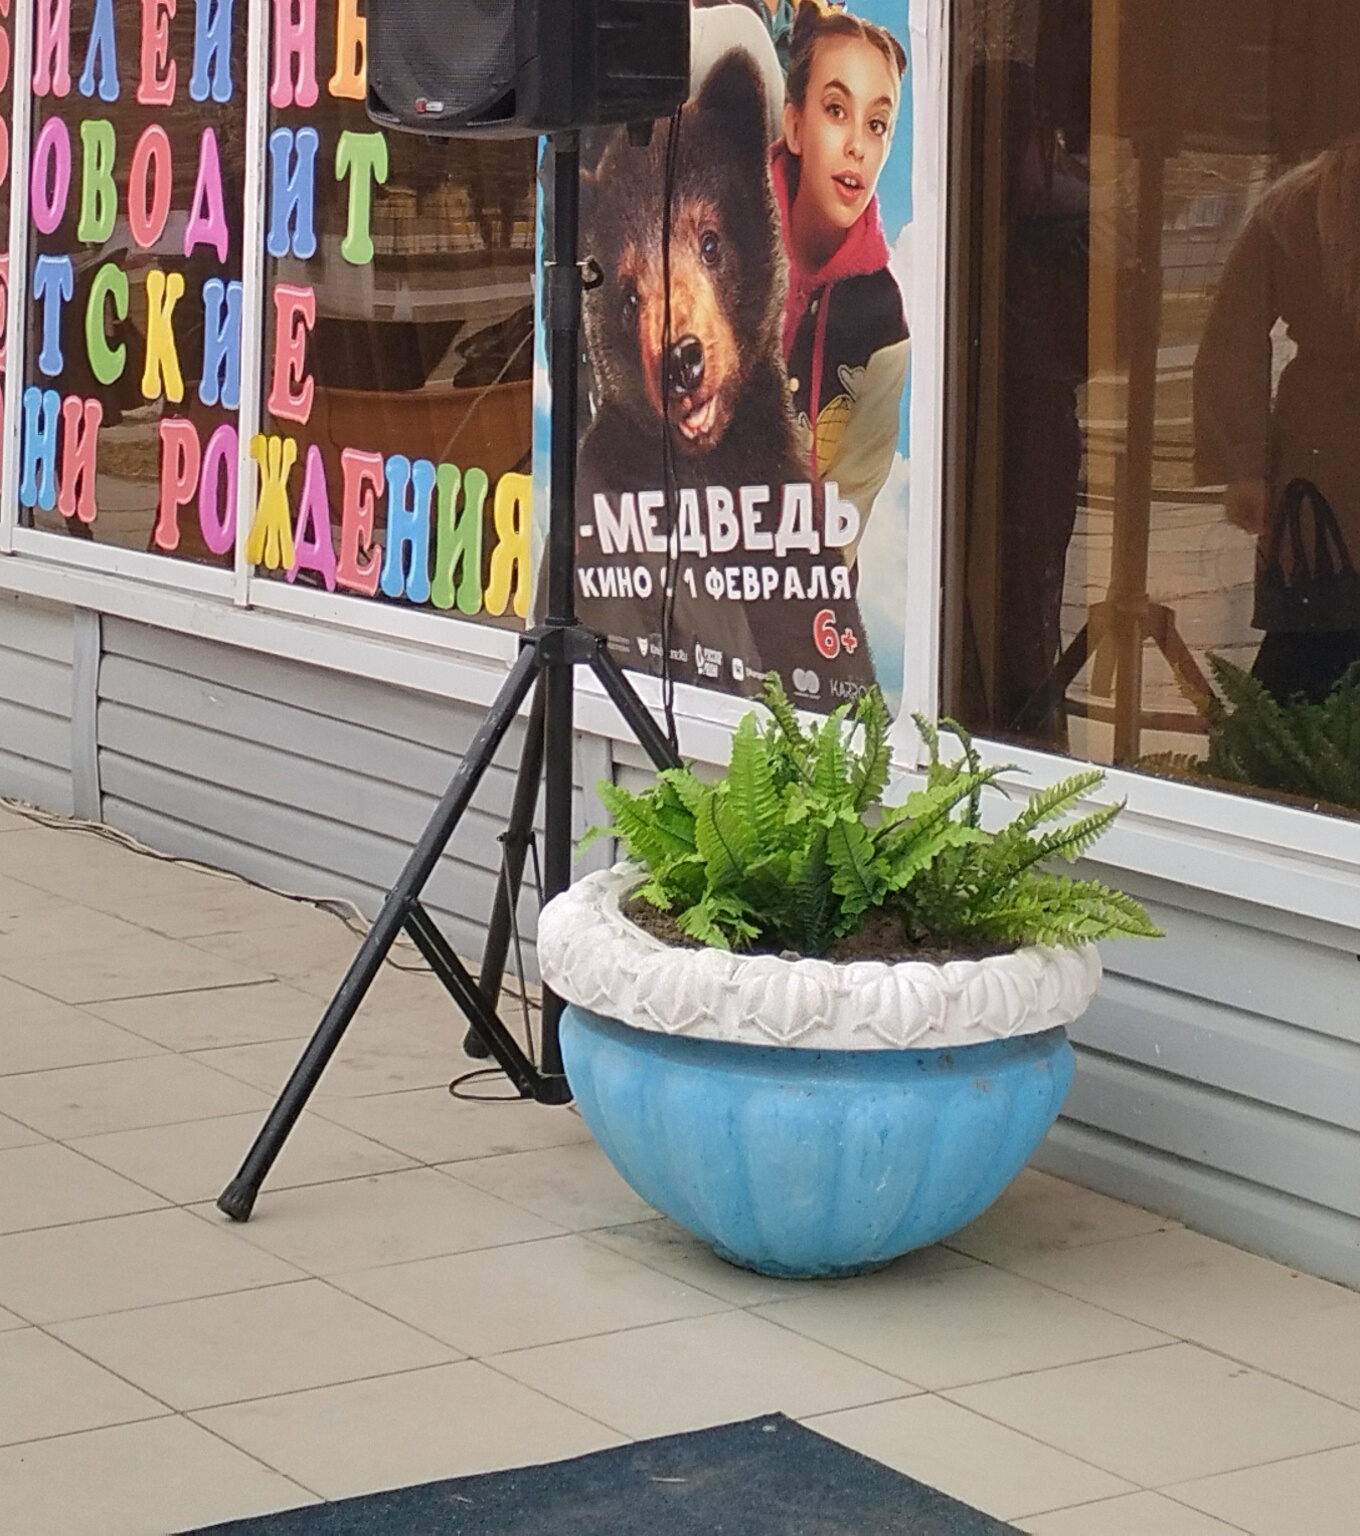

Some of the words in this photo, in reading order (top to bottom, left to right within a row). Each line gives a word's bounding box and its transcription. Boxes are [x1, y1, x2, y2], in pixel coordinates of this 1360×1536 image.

[154, 417, 532, 617] РОЖДЕНИЯ
[578, 566, 652, 599] КИНО
[705, 565, 852, 601] ФЕВРАЛЯ
[813, 609, 857, 658] 6+
